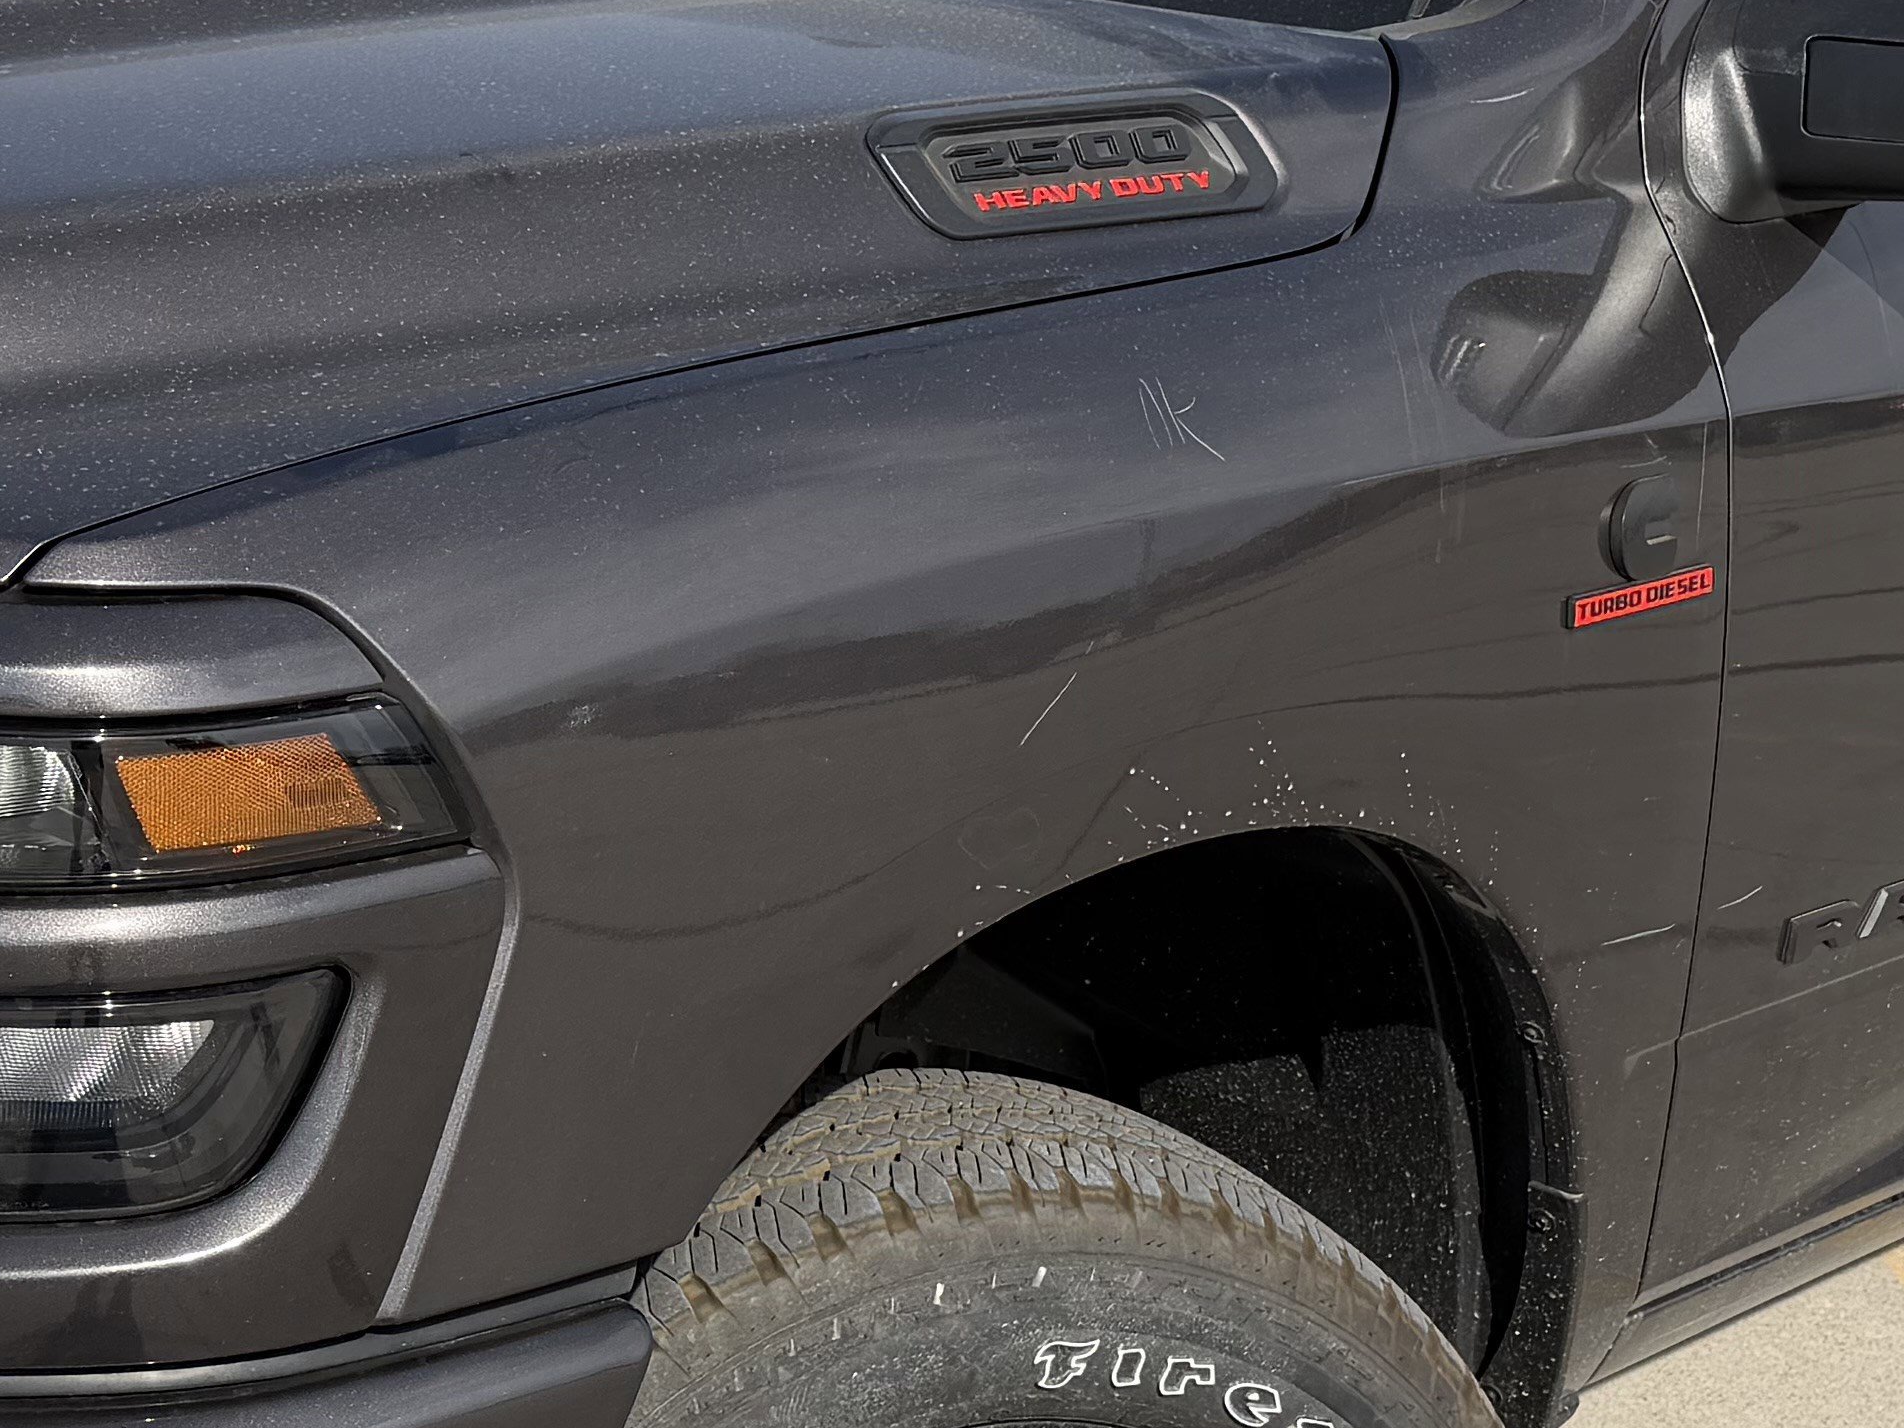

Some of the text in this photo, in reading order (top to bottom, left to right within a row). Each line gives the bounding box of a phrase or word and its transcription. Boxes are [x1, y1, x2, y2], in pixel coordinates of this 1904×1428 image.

[942, 125, 1193, 183] 2500
[973, 169, 1211, 212] HEAVY DUTY
[1577, 572, 1711, 621] TURBO DIESEL
